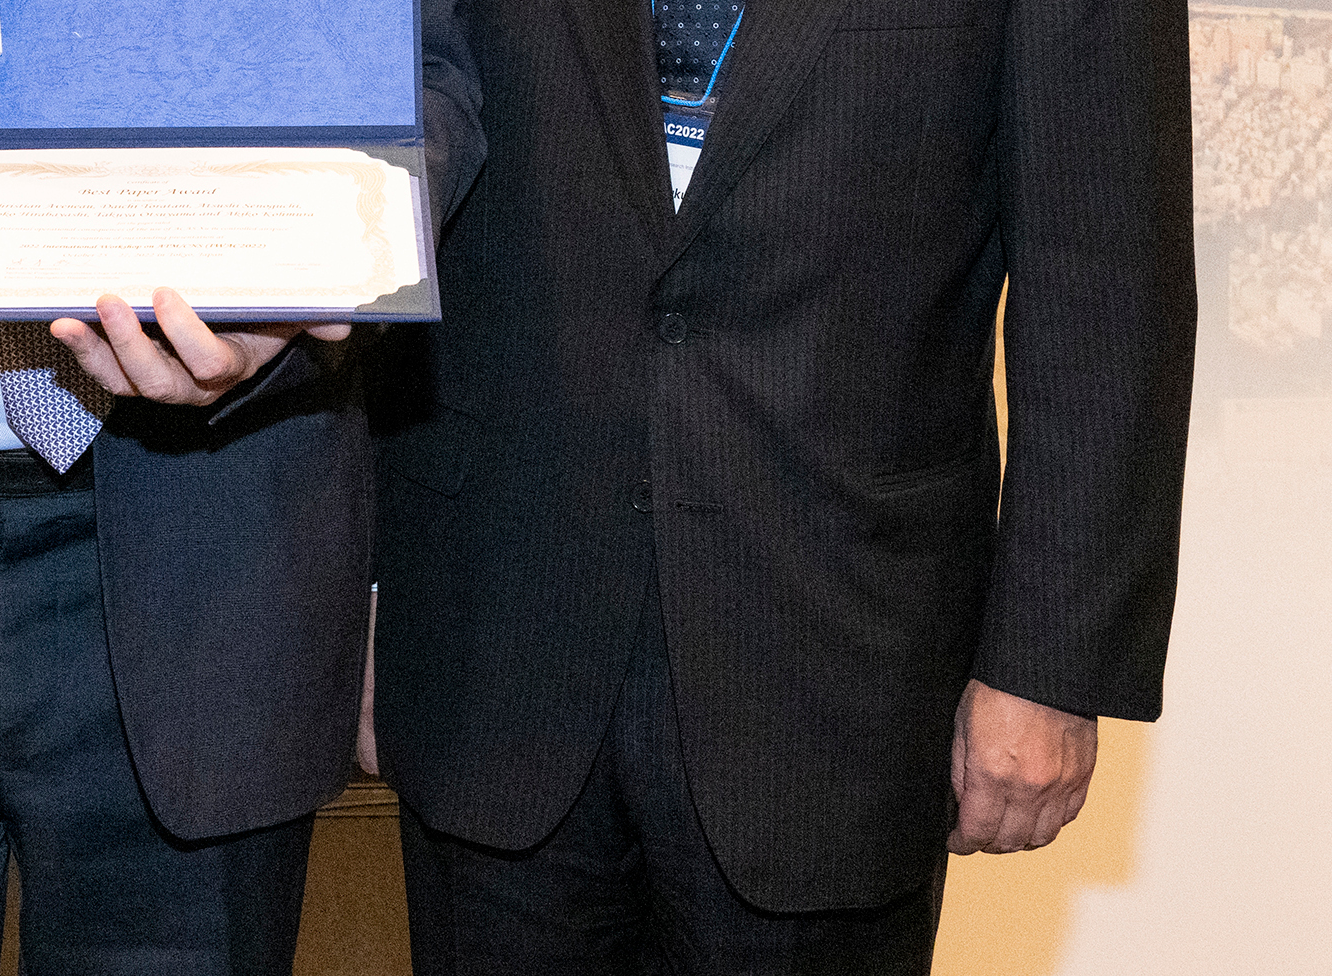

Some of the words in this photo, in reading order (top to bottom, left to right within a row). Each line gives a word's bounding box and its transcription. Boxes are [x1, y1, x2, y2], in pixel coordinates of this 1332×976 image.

[78, 188, 111, 196] Best
[116, 188, 160, 197] Paper
[164, 187, 219, 196] Award
